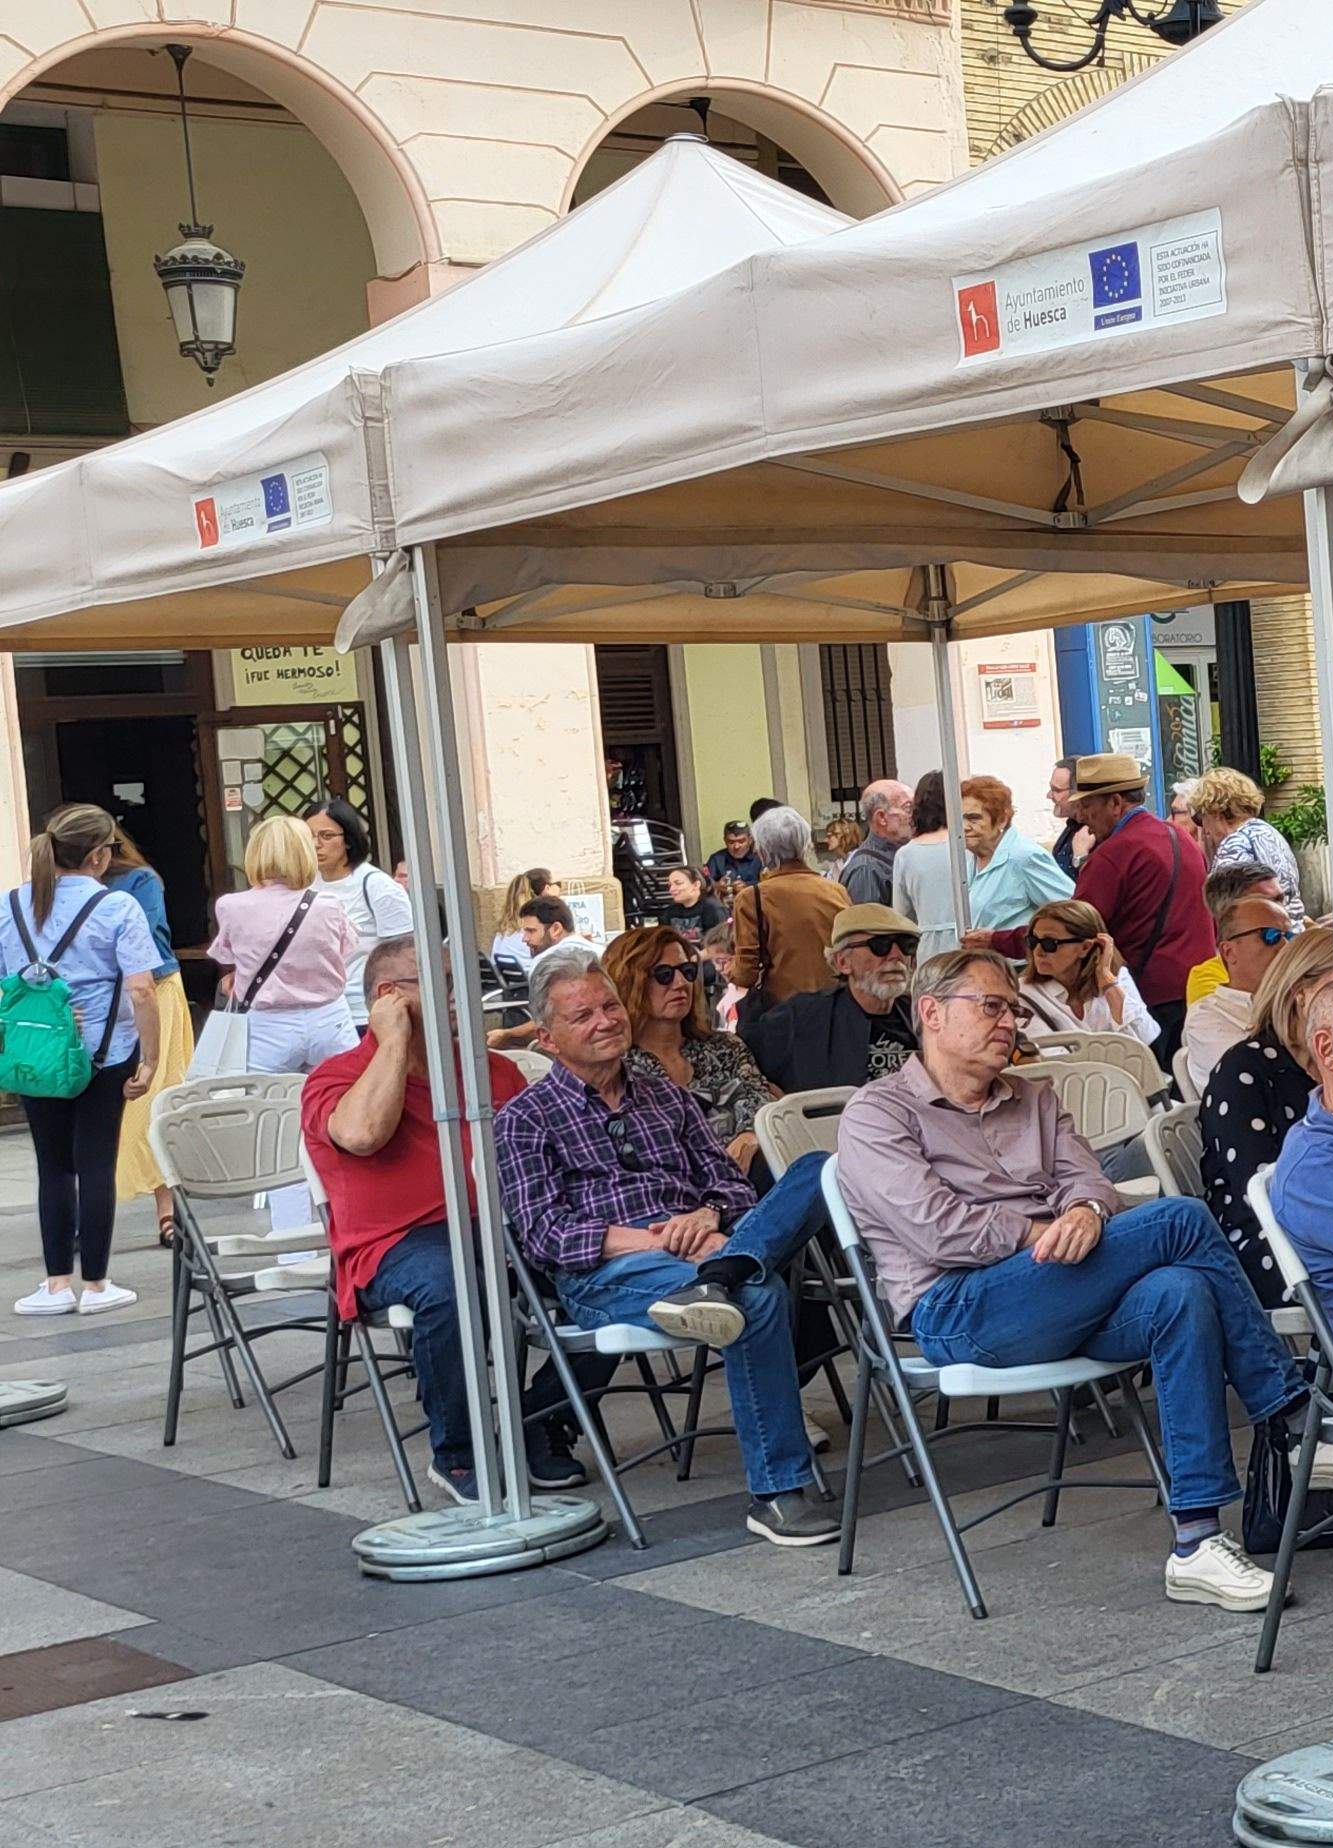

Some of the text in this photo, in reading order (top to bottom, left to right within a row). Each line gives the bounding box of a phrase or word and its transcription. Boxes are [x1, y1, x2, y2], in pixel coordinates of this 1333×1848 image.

[1005, 277, 1085, 313] Ayuntamiento
[1007, 307, 1067, 333] de Huesca
[240, 647, 292, 662] QUEDA
[277, 660, 341, 680] HERMOSO!
